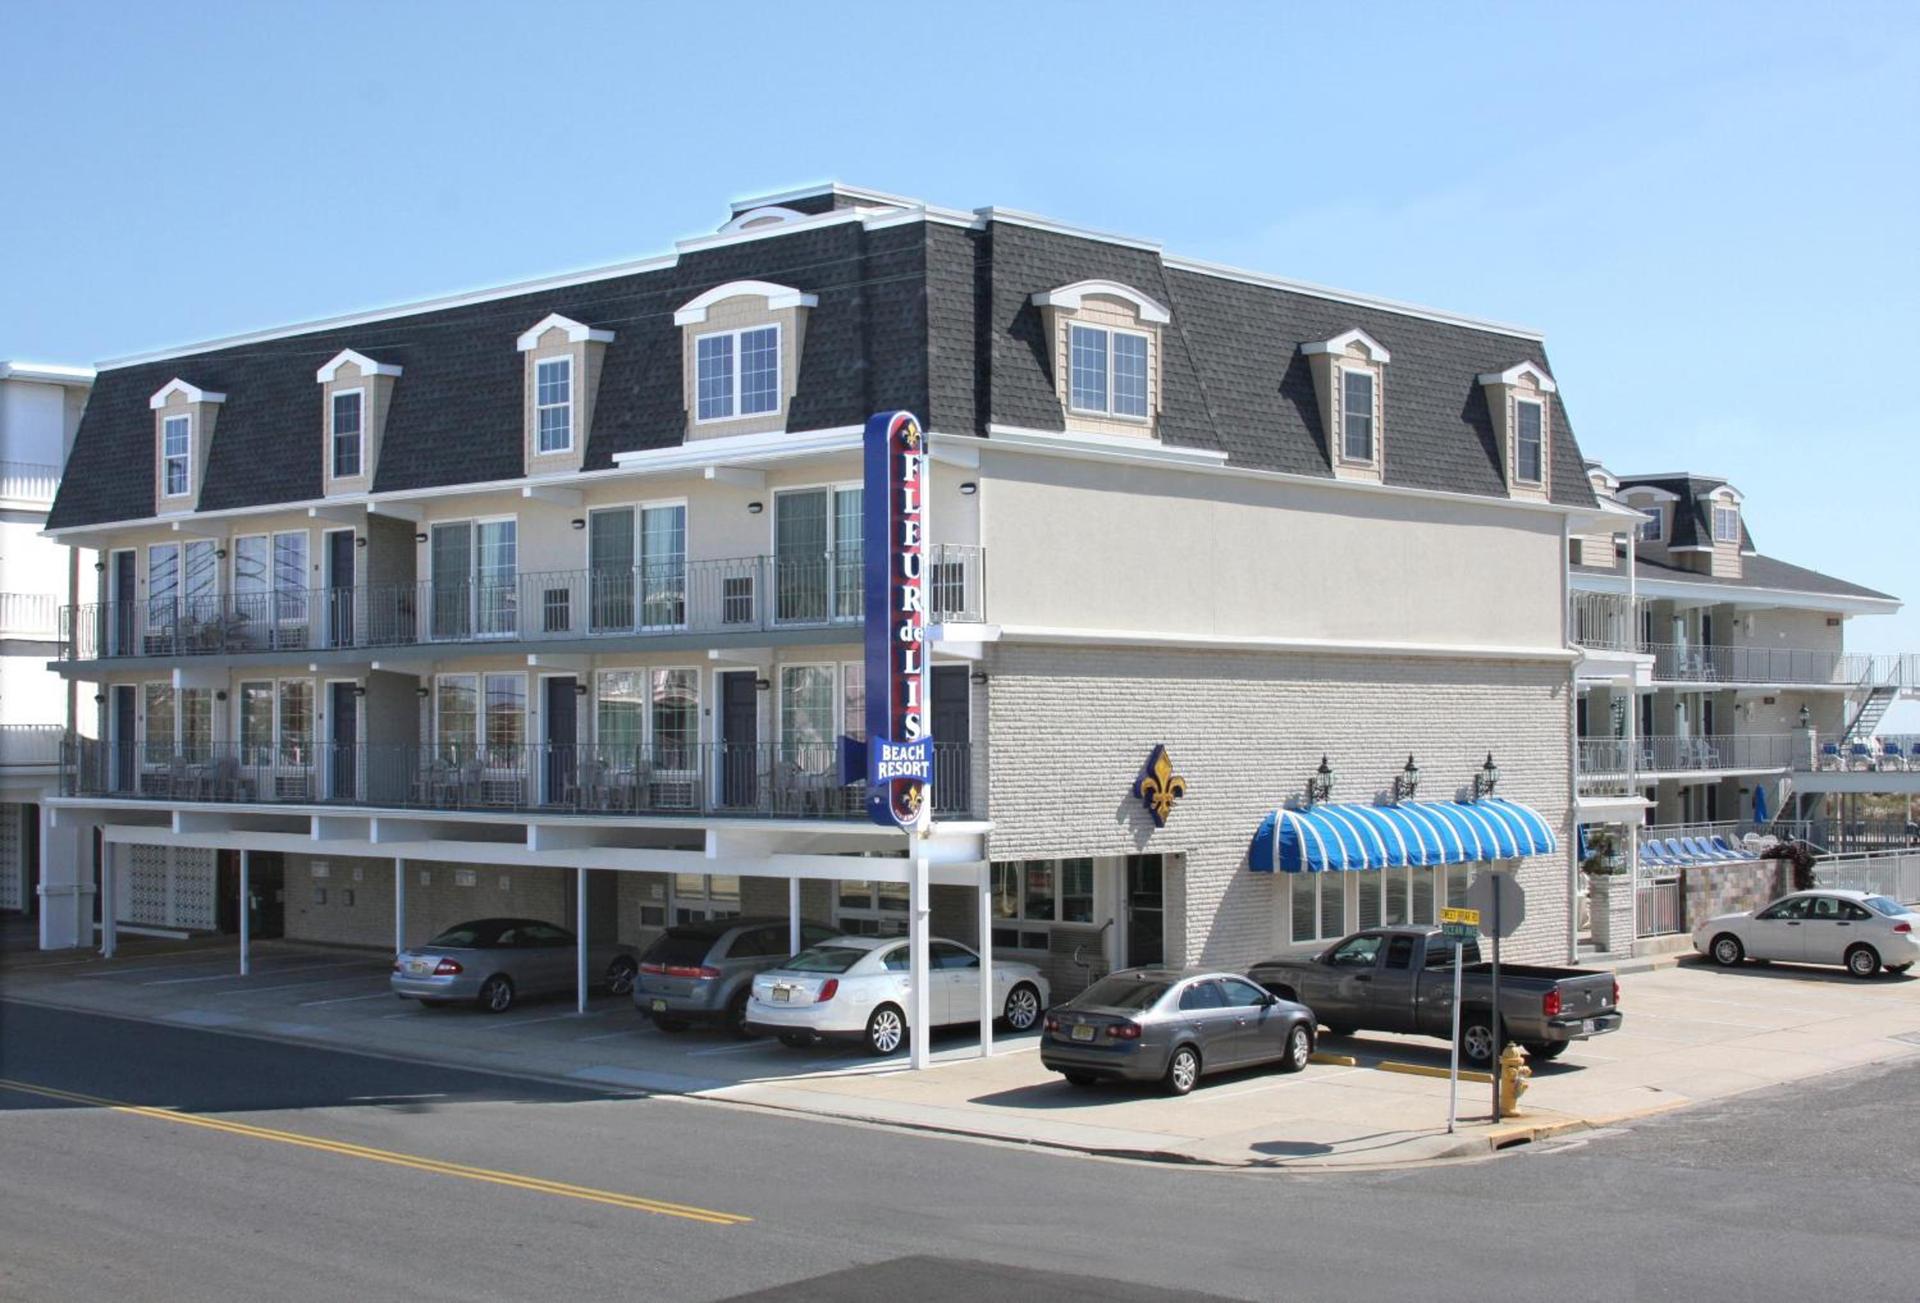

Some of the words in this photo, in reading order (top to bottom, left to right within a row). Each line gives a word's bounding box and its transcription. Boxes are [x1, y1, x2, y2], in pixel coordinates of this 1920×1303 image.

[901, 453, 922, 611] FLEUR
[900, 619, 924, 642] de
[904, 650, 921, 740] LIS
[882, 744, 925, 761] BEACH
[878, 761, 930, 780] RESORT
